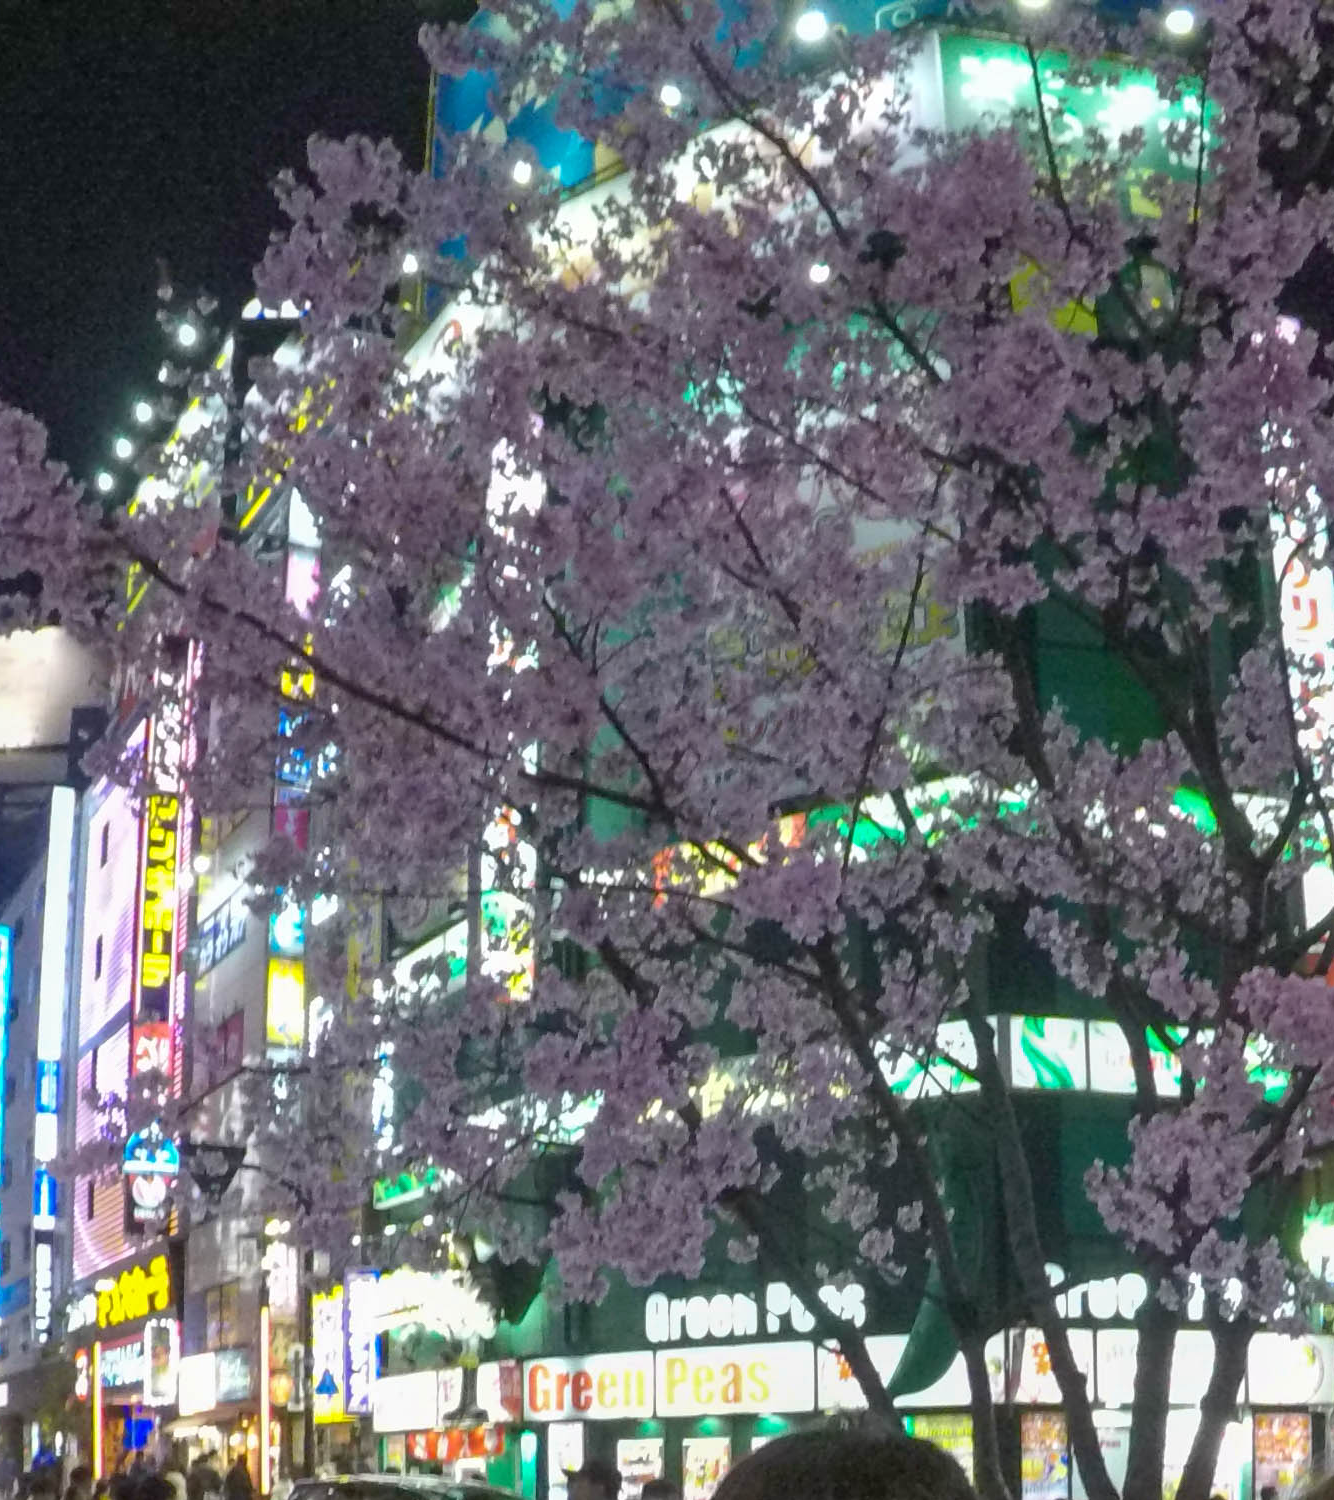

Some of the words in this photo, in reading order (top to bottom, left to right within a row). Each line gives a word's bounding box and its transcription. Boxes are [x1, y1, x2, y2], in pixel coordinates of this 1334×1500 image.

[645, 1292, 758, 1343] Green
[528, 1362, 645, 1412] Green
[666, 1357, 771, 1404] Peas
